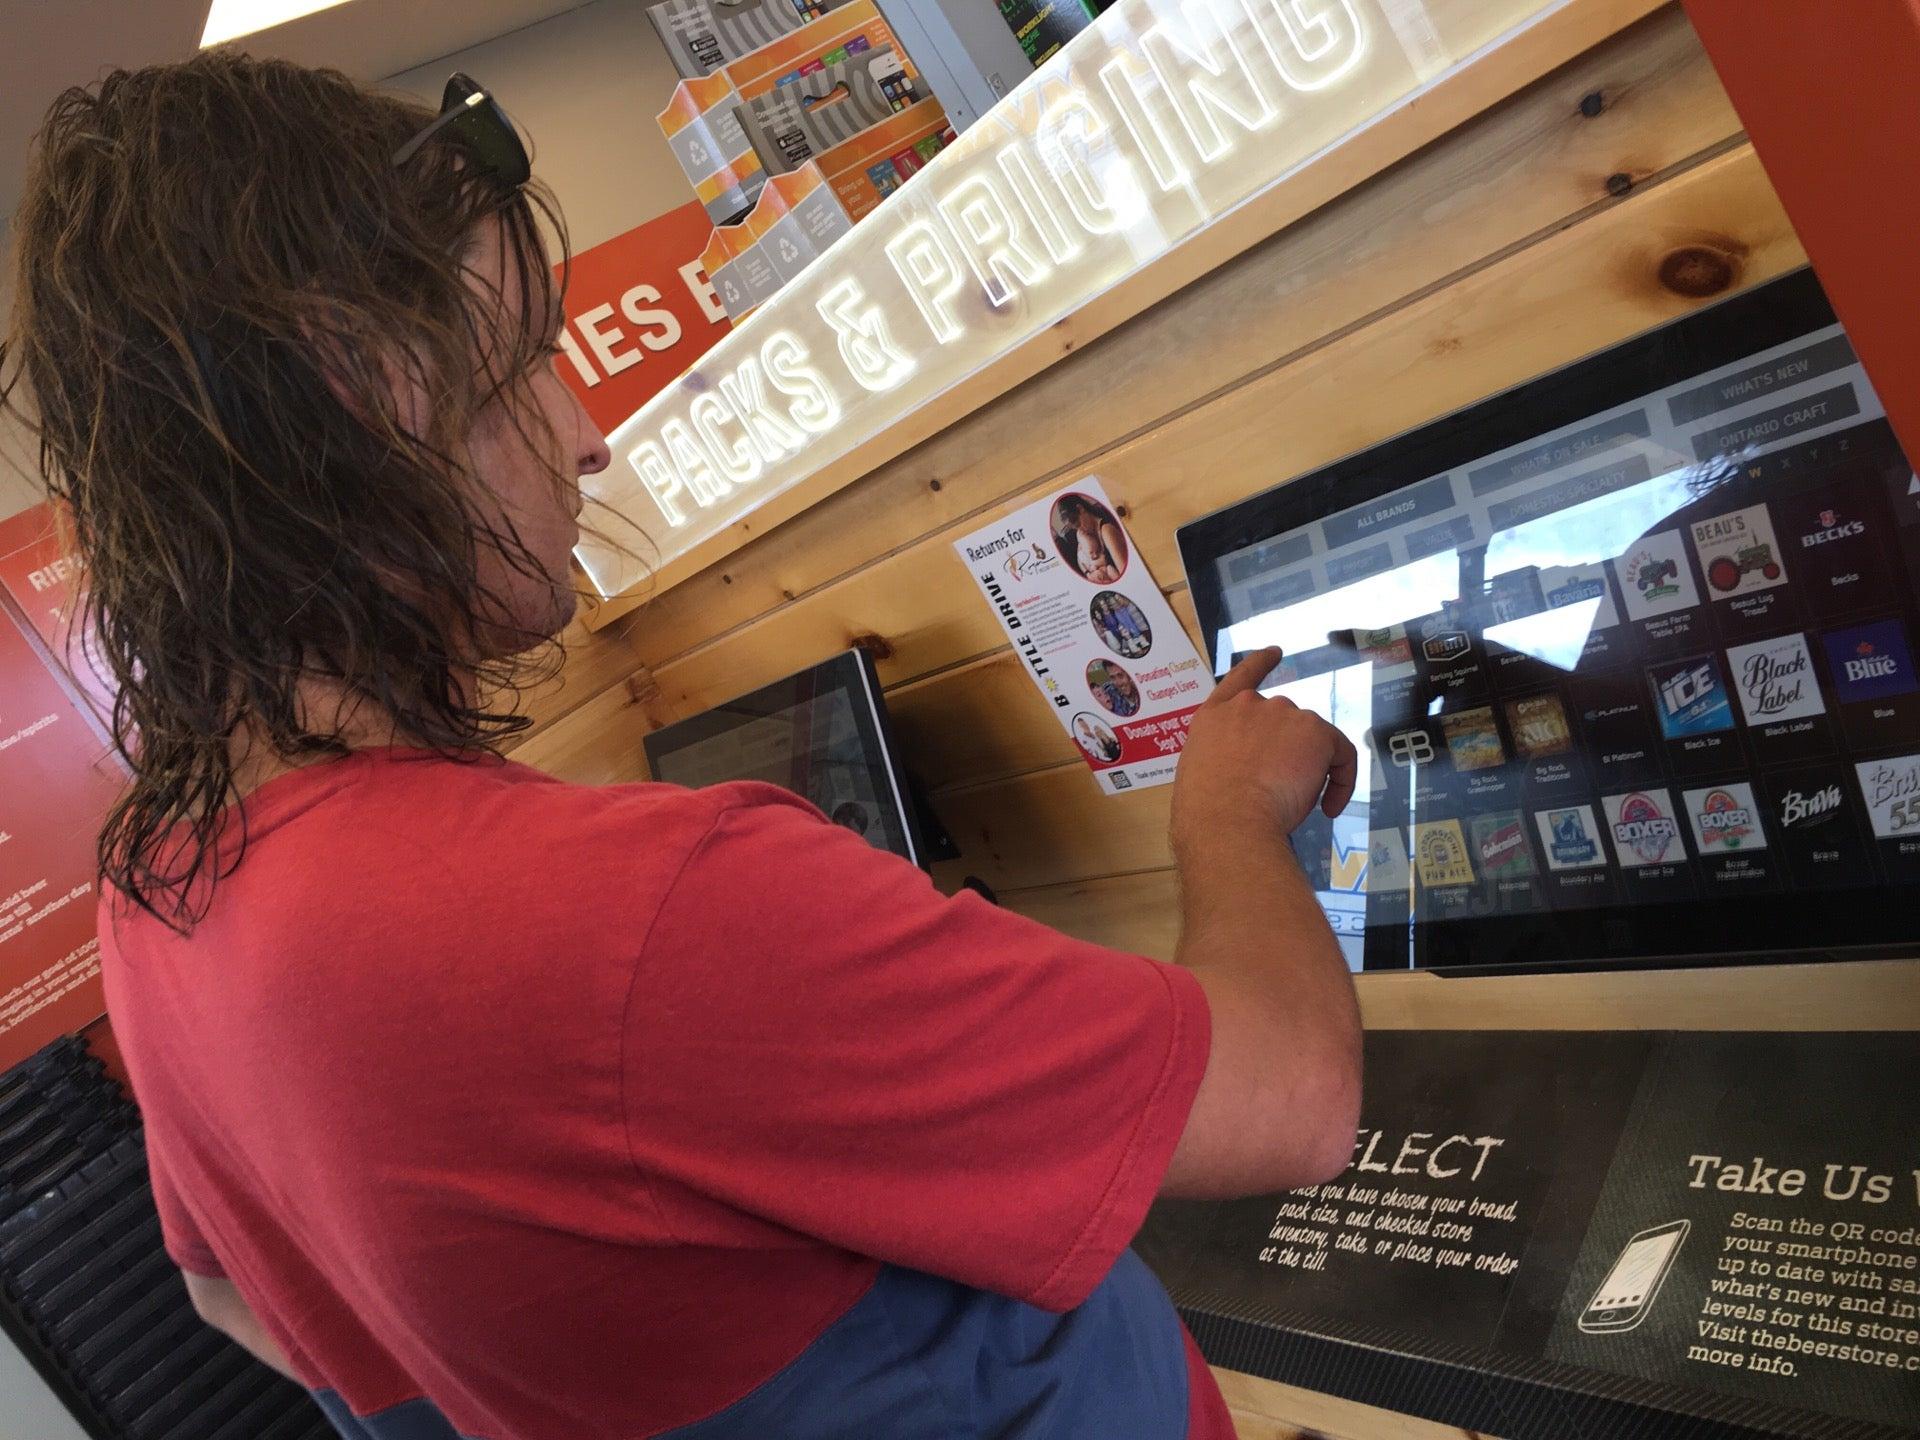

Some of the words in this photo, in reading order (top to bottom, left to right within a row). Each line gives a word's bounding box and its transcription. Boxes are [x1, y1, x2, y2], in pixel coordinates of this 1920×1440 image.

[627, 331, 842, 528] PACKS
[815, 275, 918, 393] &
[885, 0, 1368, 345] PRICING
[1721, 372, 1774, 400] WHAT'S
[1776, 359, 1810, 382] NEW
[1719, 418, 1781, 448] ONTARIO
[1783, 403, 1828, 427] CRAFT
[1573, 434, 1602, 455] SALE
[1357, 514, 1375, 529] ALL
[1376, 500, 1416, 523] BRANDS
[1696, 515, 1746, 543] BEAU'S
[966, 533, 1009, 563] Returns
[1007, 527, 1026, 545] for
[1802, 520, 1865, 548] BECK'S
[981, 571, 1021, 630] DRIVE
[1552, 584, 1602, 609] Bavaria
[1017, 634, 1070, 708] BTTLE
[1135, 666, 1172, 683] Donating
[1169, 657, 1200, 673] Change
[1742, 650, 1809, 688] Black
[1843, 656, 1898, 682] Blue
[1147, 684, 1179, 701] Changes
[1177, 679, 1199, 693] Lives
[1662, 664, 1717, 716] ICE
[1749, 679, 1805, 717] Label
[1873, 707, 1895, 719] Blue
[1123, 722, 1160, 741] Donate
[1158, 716, 1181, 736] your
[1684, 737, 1706, 750] Black
[1765, 724, 1789, 737] Black
[1789, 720, 1814, 732] Label
[1153, 735, 1179, 753] Sept
[1616, 819, 1676, 843] BOXER
[1699, 810, 1751, 829] BOXER
[69, 881, 92, 900] day
[1687, 1154, 1807, 1197] Take
[1823, 1164, 1894, 1204] Us
[1320, 1184, 1346, 1203] you
[1346, 1183, 1379, 1205] have
[1380, 1186, 1429, 1211] chosen
[1431, 1193, 1466, 1218] your
[1467, 1198, 1518, 1222] brand,
[1276, 1201, 1312, 1220] pack
[1311, 1203, 1339, 1225] size,
[1345, 1209, 1376, 1228] and
[1373, 1210, 1430, 1236] checked
[1431, 1222, 1474, 1243] store
[1730, 1212, 1785, 1232] Scan
[1788, 1217, 1826, 1237] the
[1829, 1222, 1865, 1242] QR
[1258, 1246, 1277, 1262] at
[1277, 1246, 1301, 1268] the
[1302, 1250, 1329, 1271] till.
[1268, 1221, 1329, 1250] inventory,
[1334, 1231, 1368, 1254] take,
[1374, 1240, 1393, 1255] or
[1390, 1237, 1433, 1264] place
[1434, 1246, 1472, 1269] your
[1474, 1252, 1519, 1276] order
[1722, 1235, 1773, 1253] your
[1775, 1240, 1917, 1270] smartphone
[1716, 1256, 1746, 1275] up
[1748, 1259, 1772, 1276] to
[1776, 1262, 1825, 1284] date
[1831, 1267, 1883, 1291] with
[1710, 1278, 1782, 1302] what's
[1785, 1287, 1834, 1308] new
[1838, 1292, 1886, 1316] and
[1701, 1297, 1766, 1323] levels
[1770, 1305, 1804, 1328] for
[1807, 1310, 1852, 1335] this
[1697, 1320, 1747, 1344] Visit
[1686, 1345, 1744, 1368] more
[1747, 1353, 1799, 1378] info.
